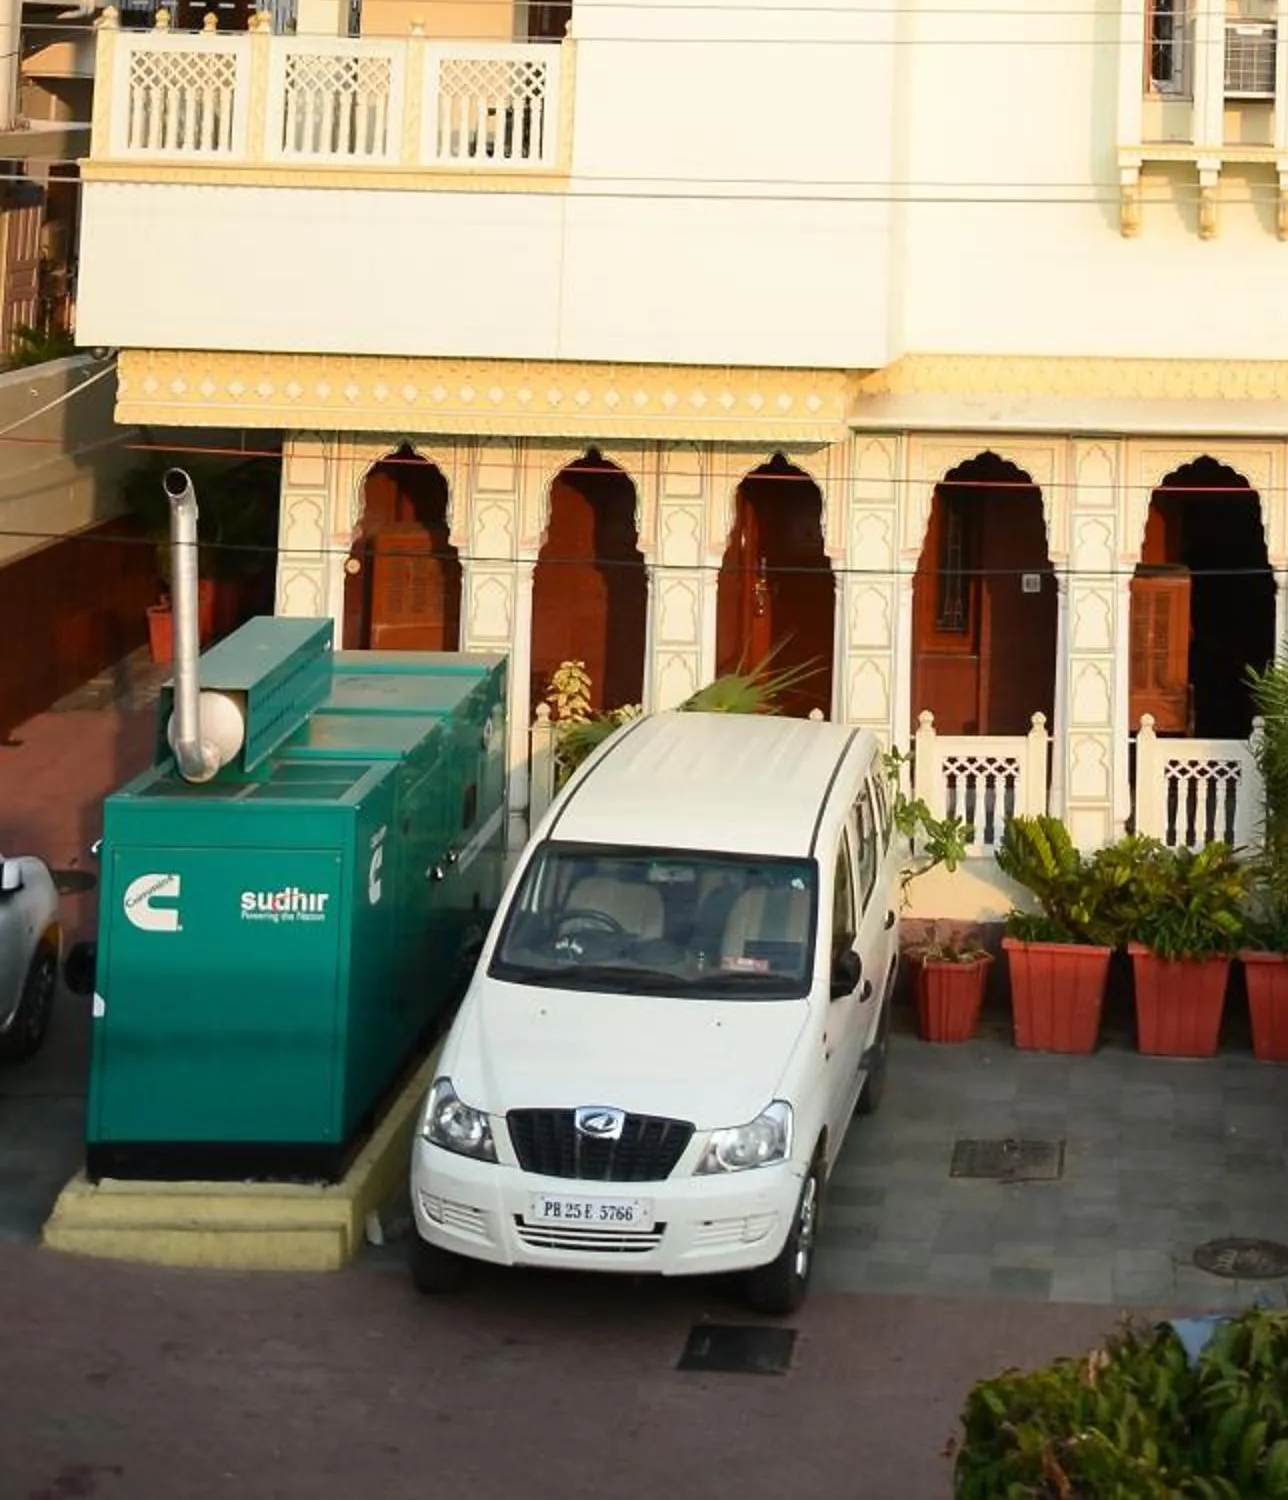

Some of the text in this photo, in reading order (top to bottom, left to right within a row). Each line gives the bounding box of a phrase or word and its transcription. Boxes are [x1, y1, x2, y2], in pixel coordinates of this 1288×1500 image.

[240, 887, 329, 912] sudhir
[543, 1201, 633, 1220] PB 25 E 5766
